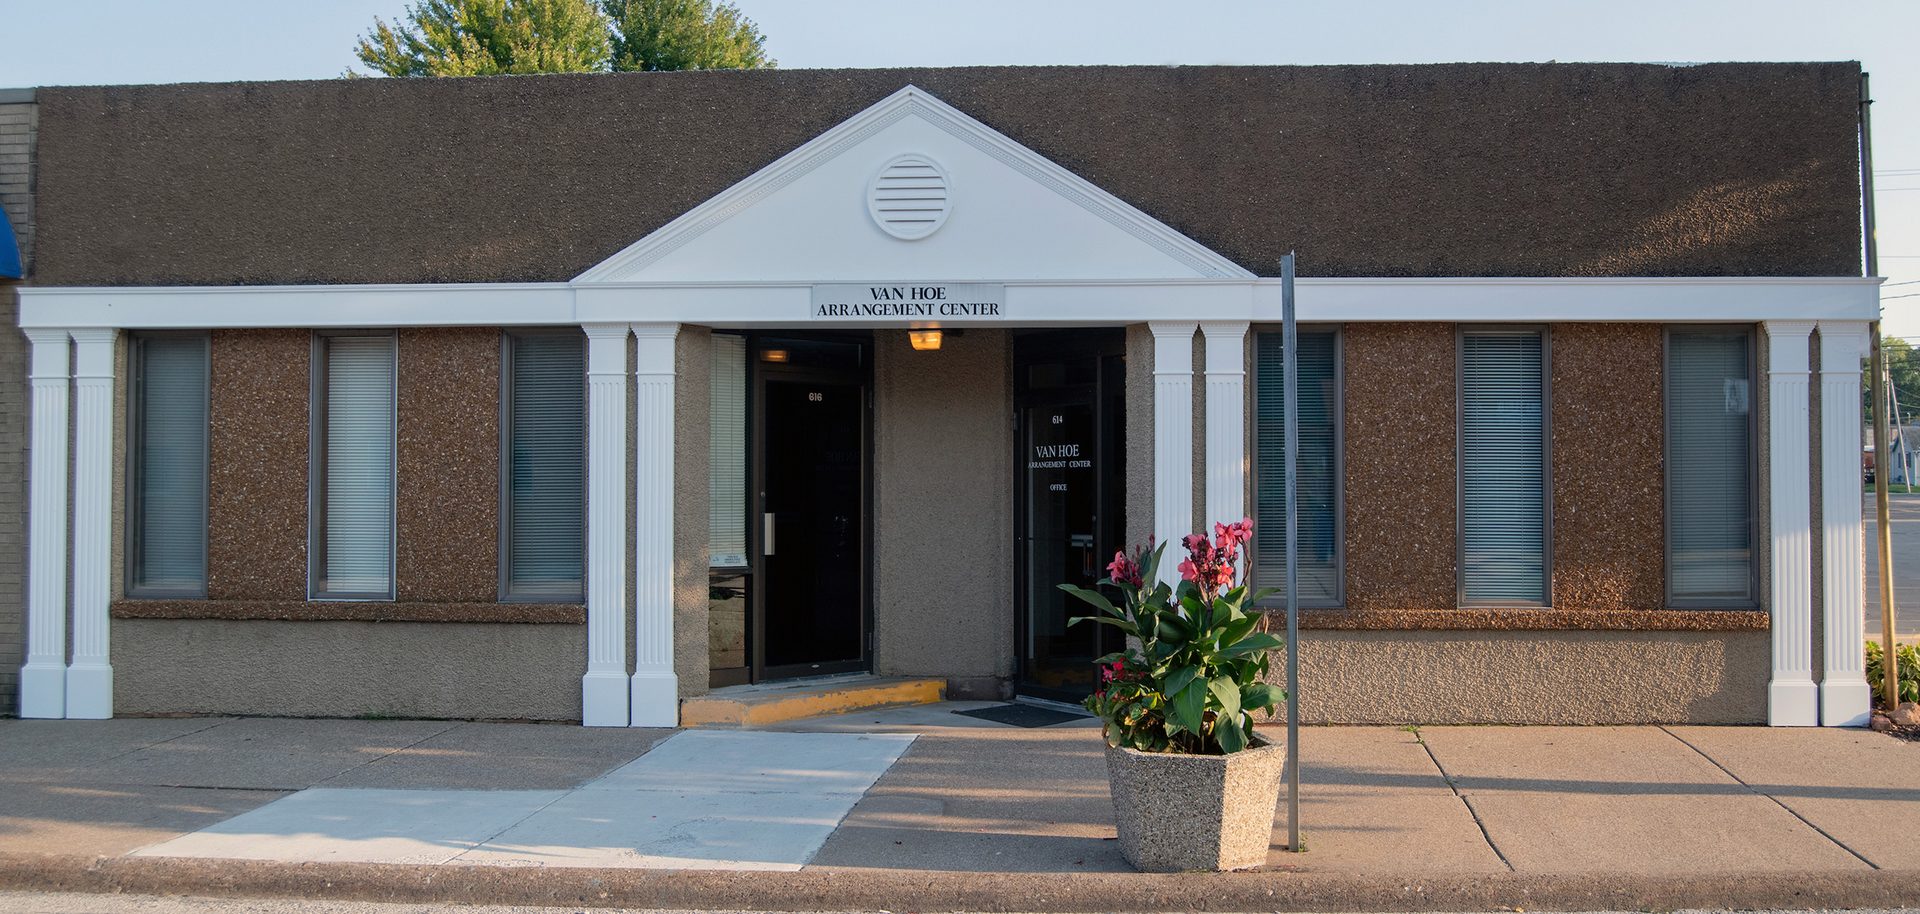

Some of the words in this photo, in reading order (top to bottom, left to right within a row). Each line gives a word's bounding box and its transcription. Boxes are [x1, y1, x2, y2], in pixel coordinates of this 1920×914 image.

[870, 287, 904, 300] VAN
[911, 287, 946, 300] HOE
[817, 303, 935, 316] ARRANGEMENT
[940, 302, 999, 316] CENTER
[808, 392, 823, 402] 616
[1052, 415, 1063, 424] 614
[1036, 445, 1056, 458] VAN
[1058, 444, 1079, 457] HOE
[1028, 460, 1066, 469] ARRANGEMENT
[1069, 460, 1091, 468] CENTER
[1049, 483, 1067, 491] OFFICE
